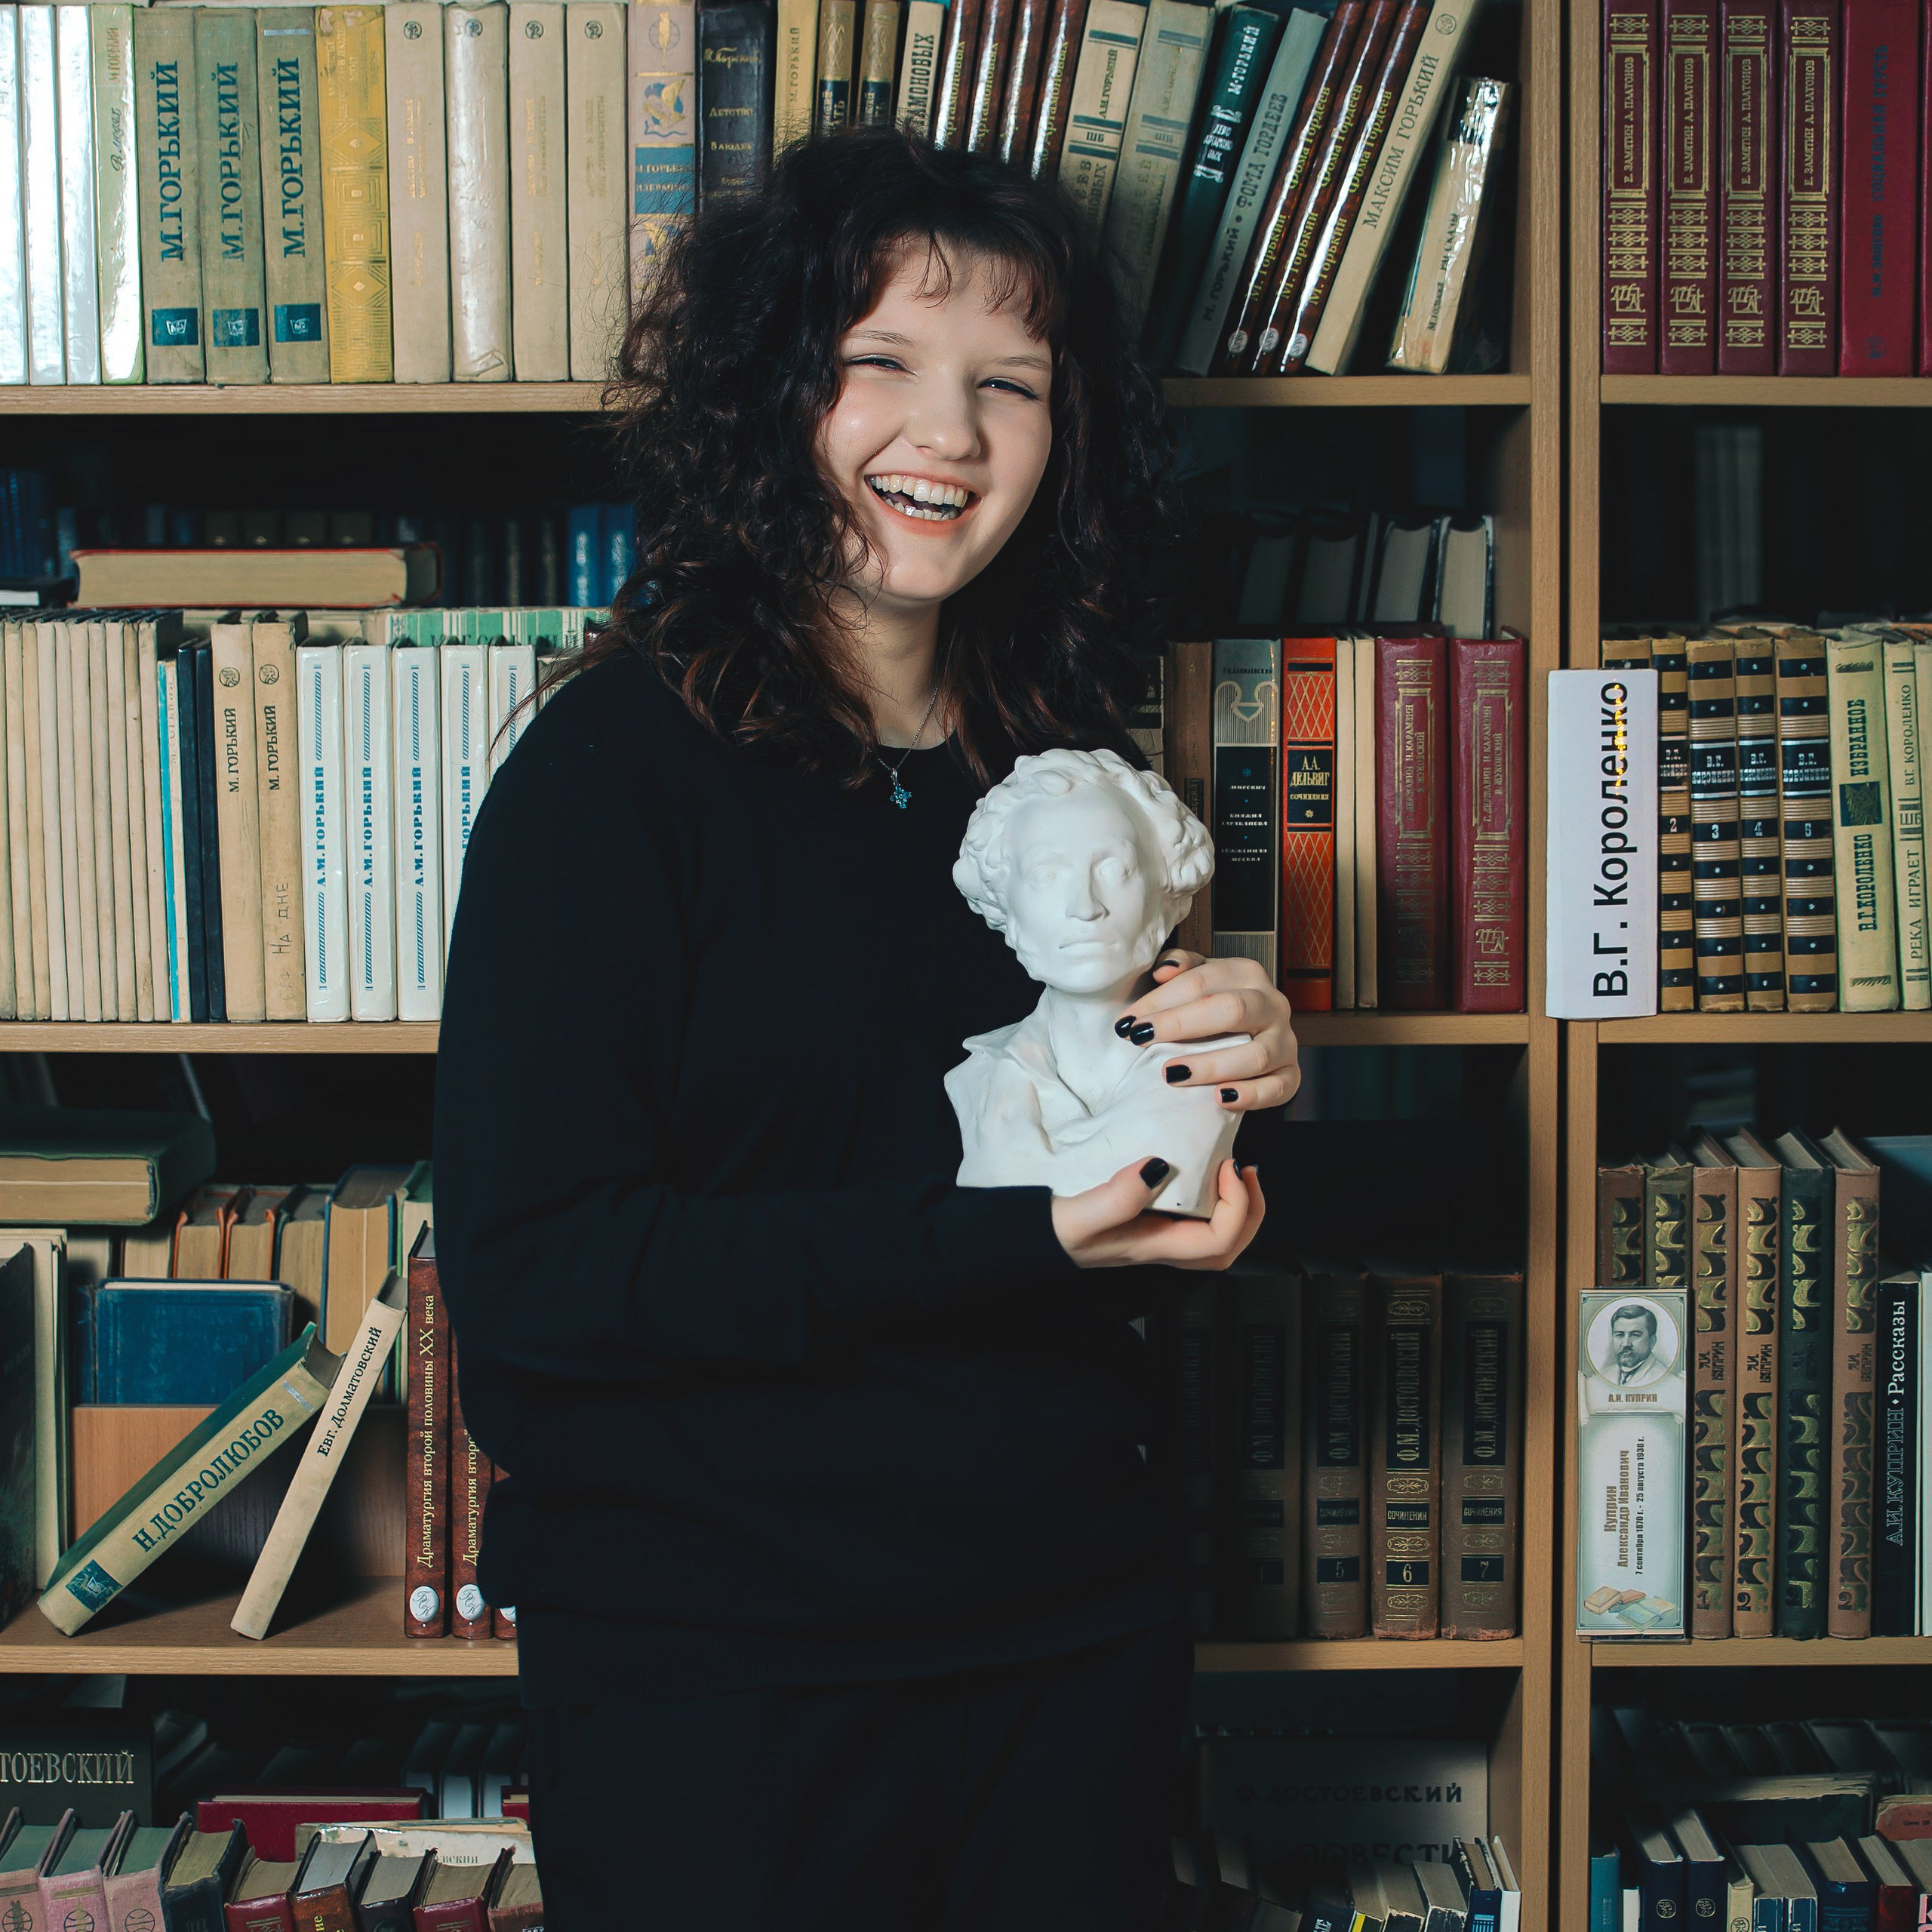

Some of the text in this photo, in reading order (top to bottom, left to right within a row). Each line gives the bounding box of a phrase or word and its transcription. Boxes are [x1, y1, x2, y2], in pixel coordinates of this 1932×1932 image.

[1624, 57, 1634, 109] ПЛАТОНОВ
[1684, 57, 1694, 110] ПЛАТОНОВ
[1742, 58, 1751, 111] ПЛАТОНОВ
[1804, 60, 1814, 112] ПЛАТОНОВ
[1872, 45, 1888, 99] ГРУСТЬ
[150, 60, 183, 262] М.ГОРЬКИЙ
[211, 62, 244, 263] М.ГОРЬКИЙ
[272, 57, 306, 258] М.ГОРЬКИЙ
[1236, 162, 1267, 208] ФОМА
[1252, 92, 1289, 157] ГОРДЕЕВ
[1361, 53, 1440, 230] МАКСИМ ГОРЬКИЙ
[223, 707, 240, 793] М. ГОРЬКИЙ
[263, 705, 280, 791] М. ГОРЬКИЙ
[1405, 704, 1414, 751] КАРАМЗИН
[1483, 706, 1491, 752] КАРАМЗИН
[1847, 699, 1869, 777] ИЗБРАННОЕ
[1900, 685, 1915, 764] КОРОЛЕНКО
[1290, 772, 1330, 787] ДЕЛЬВИГ
[1302, 756, 1321, 770] А.А.
[1414, 731, 1425, 783] ЖУКОВСКИЙ
[1492, 733, 1502, 785] ЖУКОВСКИЙ
[1483, 767, 1492, 813] ДЕРЖАВИН
[315, 767, 326, 888] А.М.ГОРЬКИЙ
[362, 767, 373, 888] А.М.ГОРЬКИЙ
[411, 768, 423, 887] А.М.ГОРЬКИЙ
[1592, 681, 1638, 998] В.Г. Короленко
[1669, 817, 1677, 832] 2
[1712, 824, 1719, 839] 3
[1754, 821, 1763, 836] 4
[1804, 823, 1812, 837] 5
[1906, 849, 1923, 959] РЕКА ИГРАЕТ
[422, 1294, 435, 1325] века
[1887, 1300, 1906, 1395] Рассказы
[315, 1326, 384, 1458] Евг. Долматовский
[421, 1360, 435, 1427] половины
[1625, 1393, 1657, 1403] КУПРИН
[420, 1430, 435, 1477] второй
[1636, 1442, 1644, 1461] 1938
[1887, 1408, 1904, 1503] КУПРИН
[131, 1407, 286, 1553] Н.ДОБРОЛЮБОВ
[1636, 1493, 1644, 1502] 25
[417, 1480, 435, 1568] Драматургия
[462, 1478, 481, 1566] Драматургия
[1387, 1509, 1427, 1521] СОЧИНЕНИЯ
[1604, 1486, 1618, 1532] Куприн
[1617, 1451, 1630, 1567] Александр Иванович
[1635, 1516, 1644, 1532] 1870
[1336, 1561, 1345, 1578] 5
[1403, 1563, 1413, 1583] 6
[1479, 1561, 1489, 1578] 7
[1635, 1534, 1644, 1570] сентября
[1696, 1590, 1710, 1610] 1
[1737, 1592, 1751, 1611] 2
[1838, 1591, 1852, 1611] 2
[0, 1749, 134, 1783] ТОЕВСКИЙ
